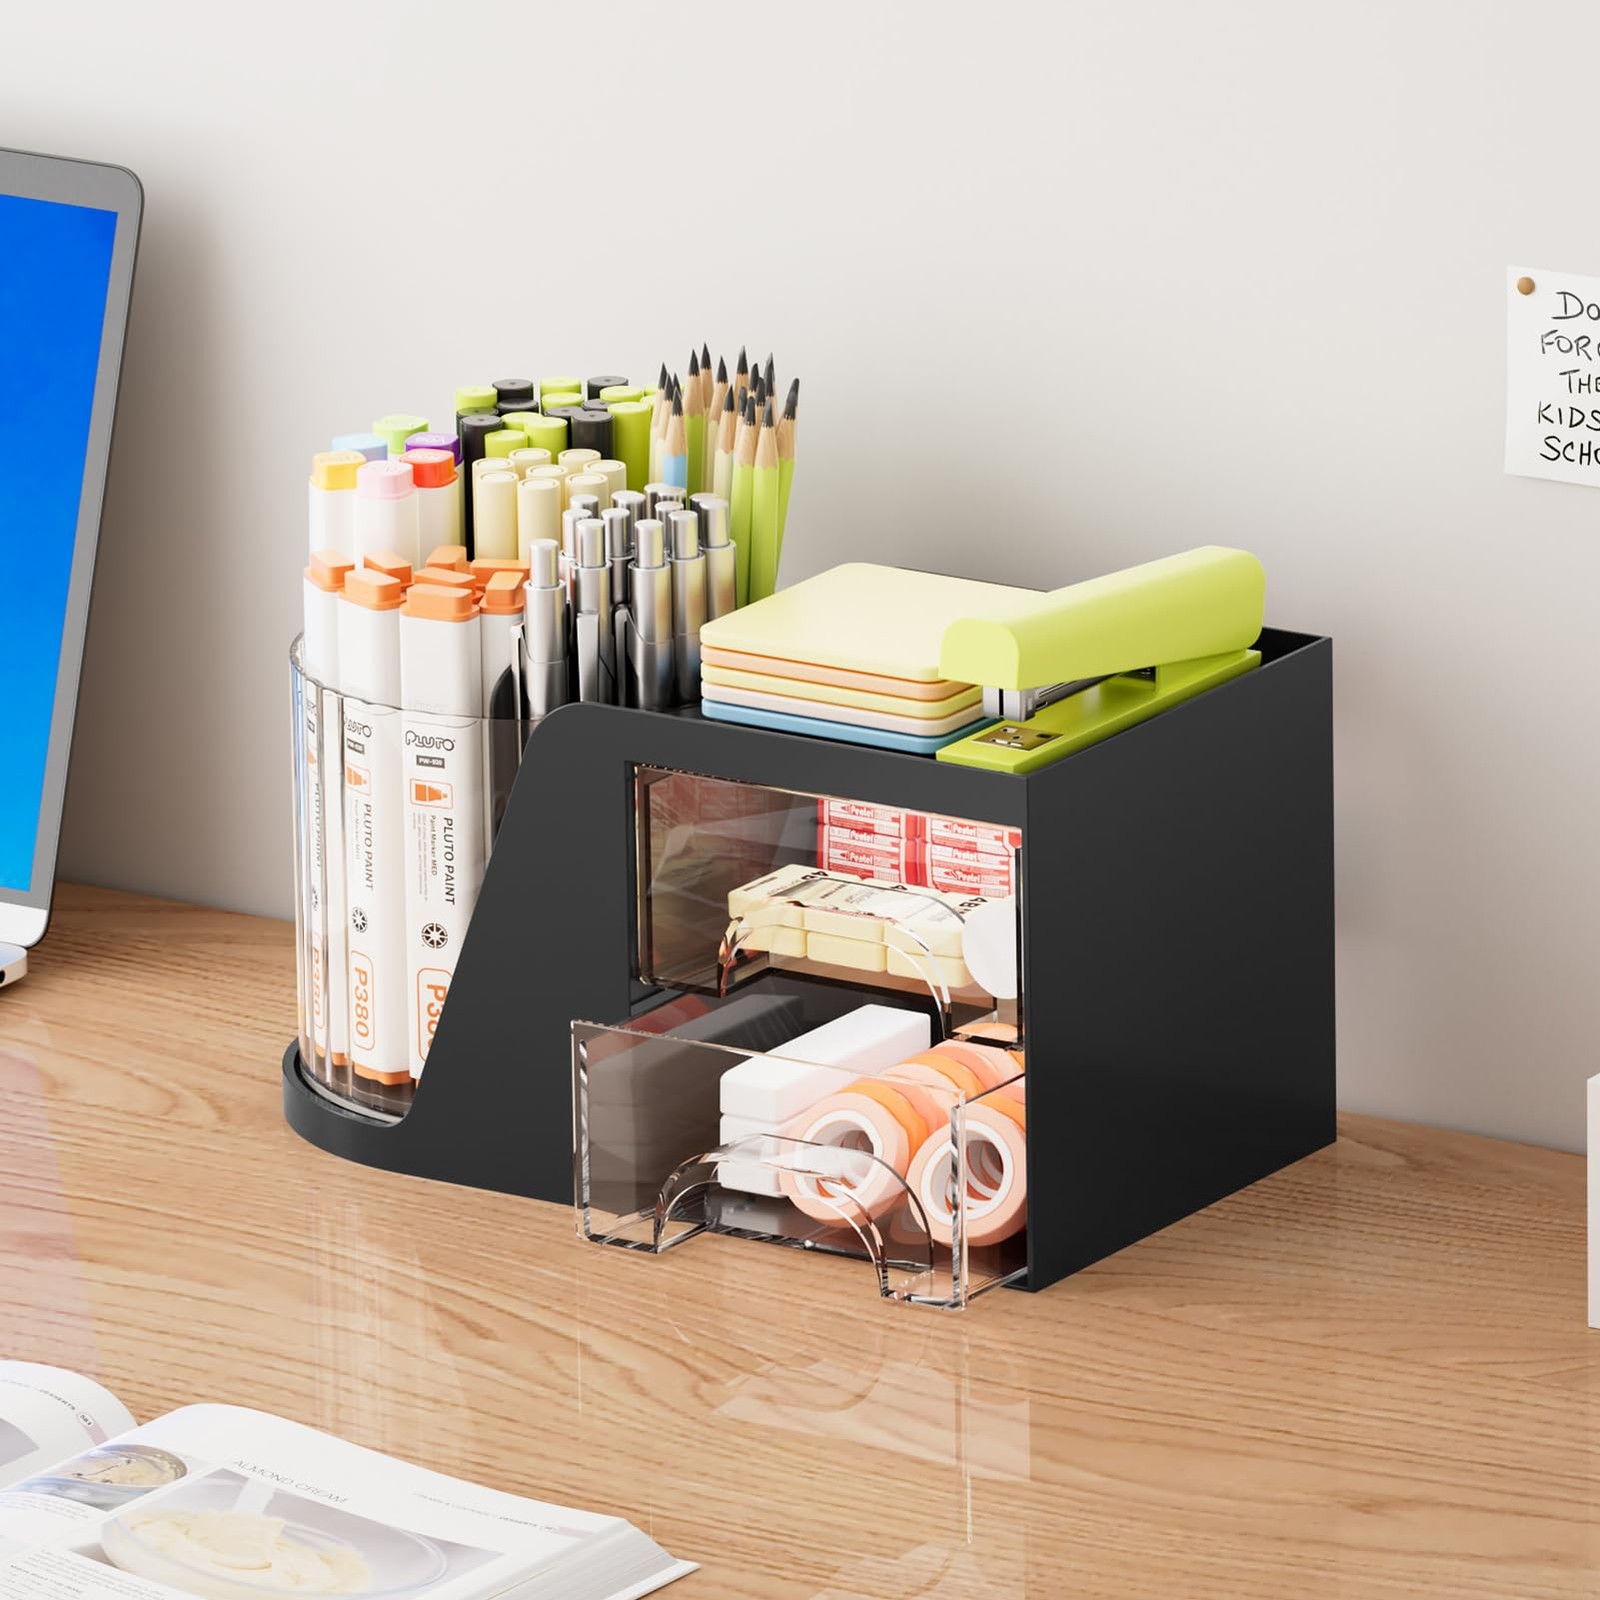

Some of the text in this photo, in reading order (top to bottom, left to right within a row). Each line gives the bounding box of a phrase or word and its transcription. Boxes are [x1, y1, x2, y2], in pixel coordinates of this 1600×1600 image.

[1540, 329, 1600, 361] FOR
[1538, 400, 1600, 431] KIDS
[405, 730, 455, 751] PLUTO
[363, 803, 374, 891] PLUTO PAINT
[443, 817, 455, 906] PLUTO PAINT
[354, 967, 370, 1038] P380
[426, 984, 447, 1048] P3
[232, 1458, 294, 1485] ALMOND
